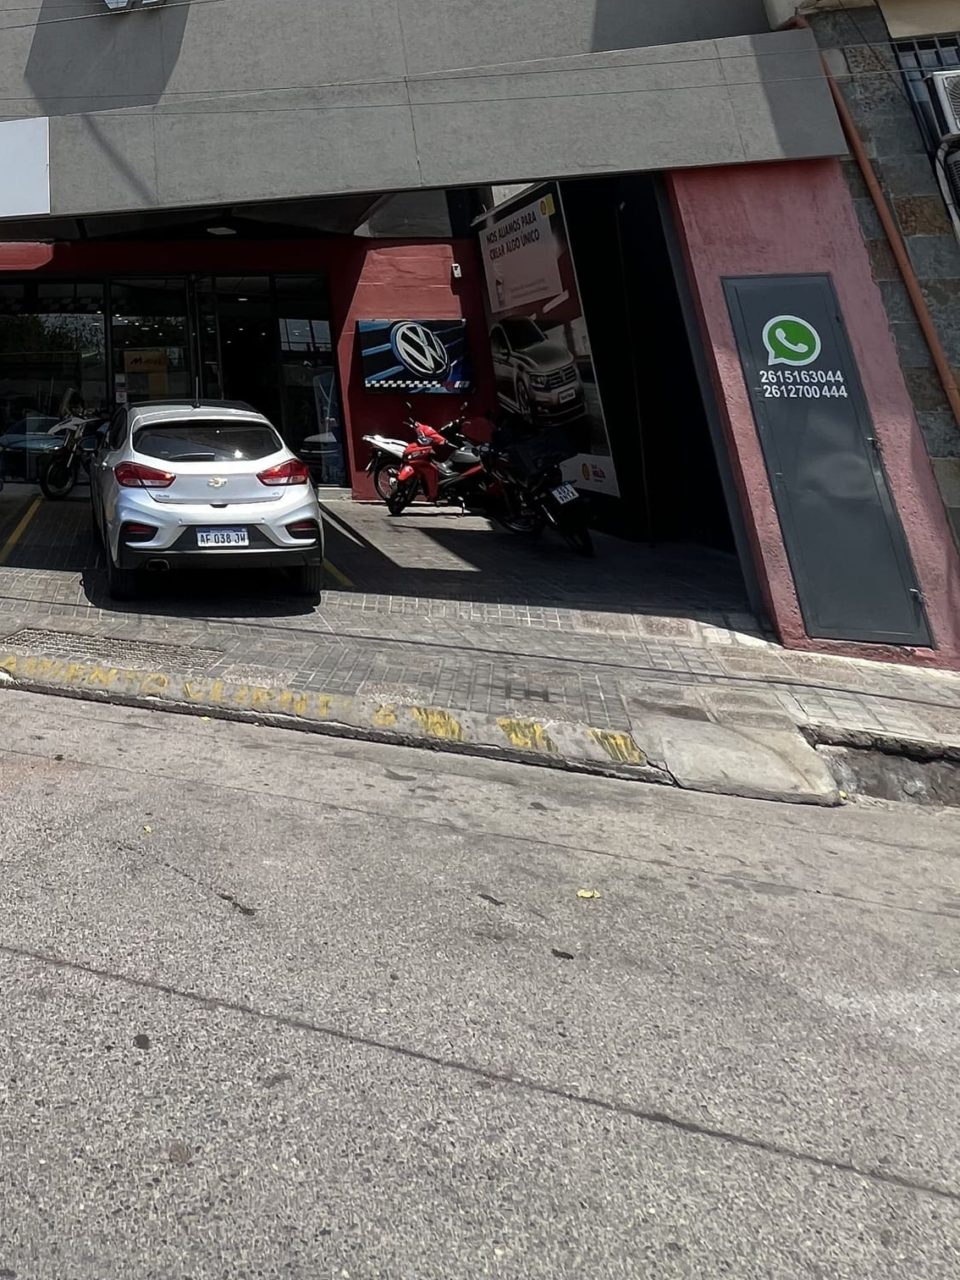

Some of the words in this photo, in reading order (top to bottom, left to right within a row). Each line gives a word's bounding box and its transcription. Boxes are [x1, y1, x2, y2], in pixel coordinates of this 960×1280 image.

[521, 210, 537, 228] PARA
[759, 370, 844, 383] 2615163044
[200, 533, 211, 544] AF
[213, 533, 232, 544] 038
